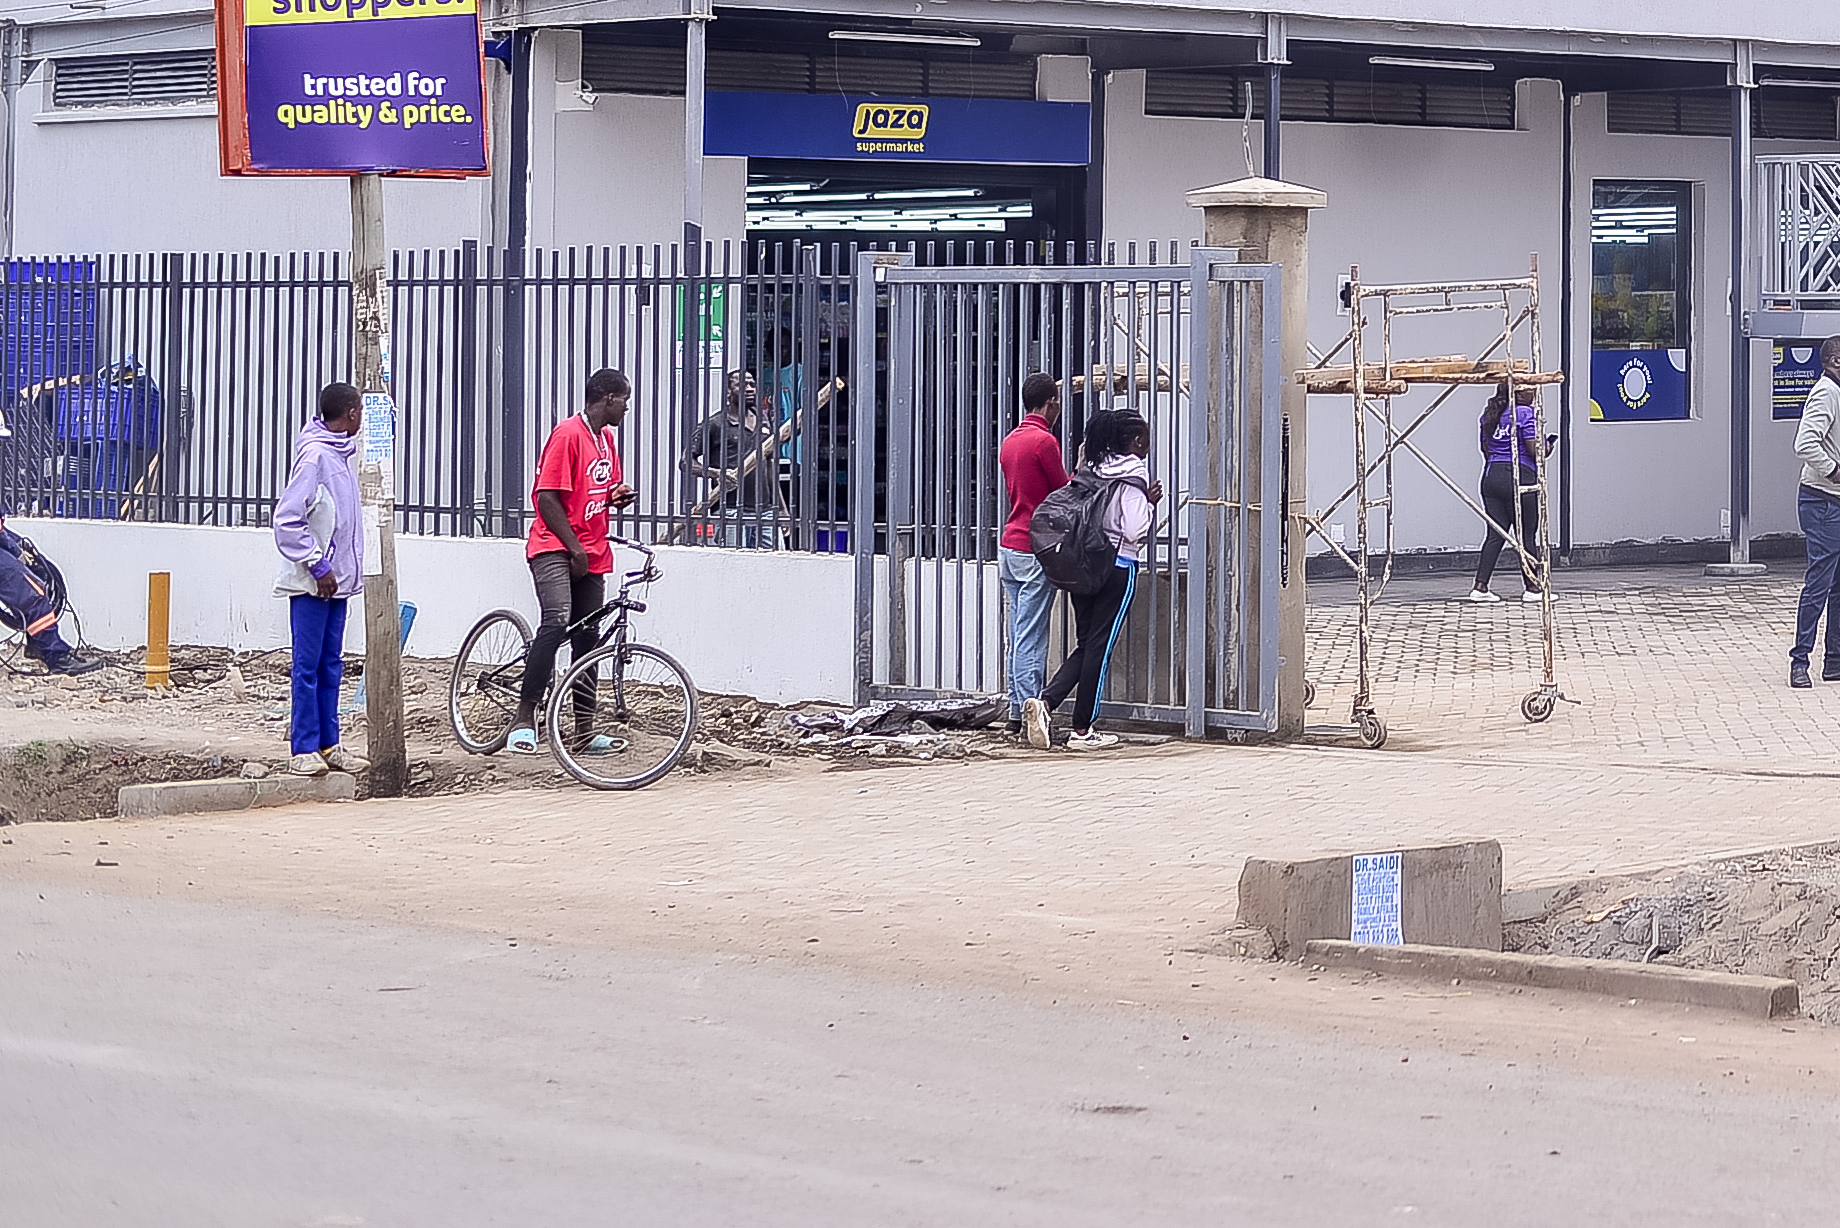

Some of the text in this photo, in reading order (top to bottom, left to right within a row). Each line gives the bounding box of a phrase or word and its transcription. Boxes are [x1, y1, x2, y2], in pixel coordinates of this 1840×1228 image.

[303, 71, 447, 96] trusted for
[276, 97, 474, 130] quality & price.
[856, 140, 926, 154] supermarket
[1355, 855, 1399, 873] DR.SAIDI
